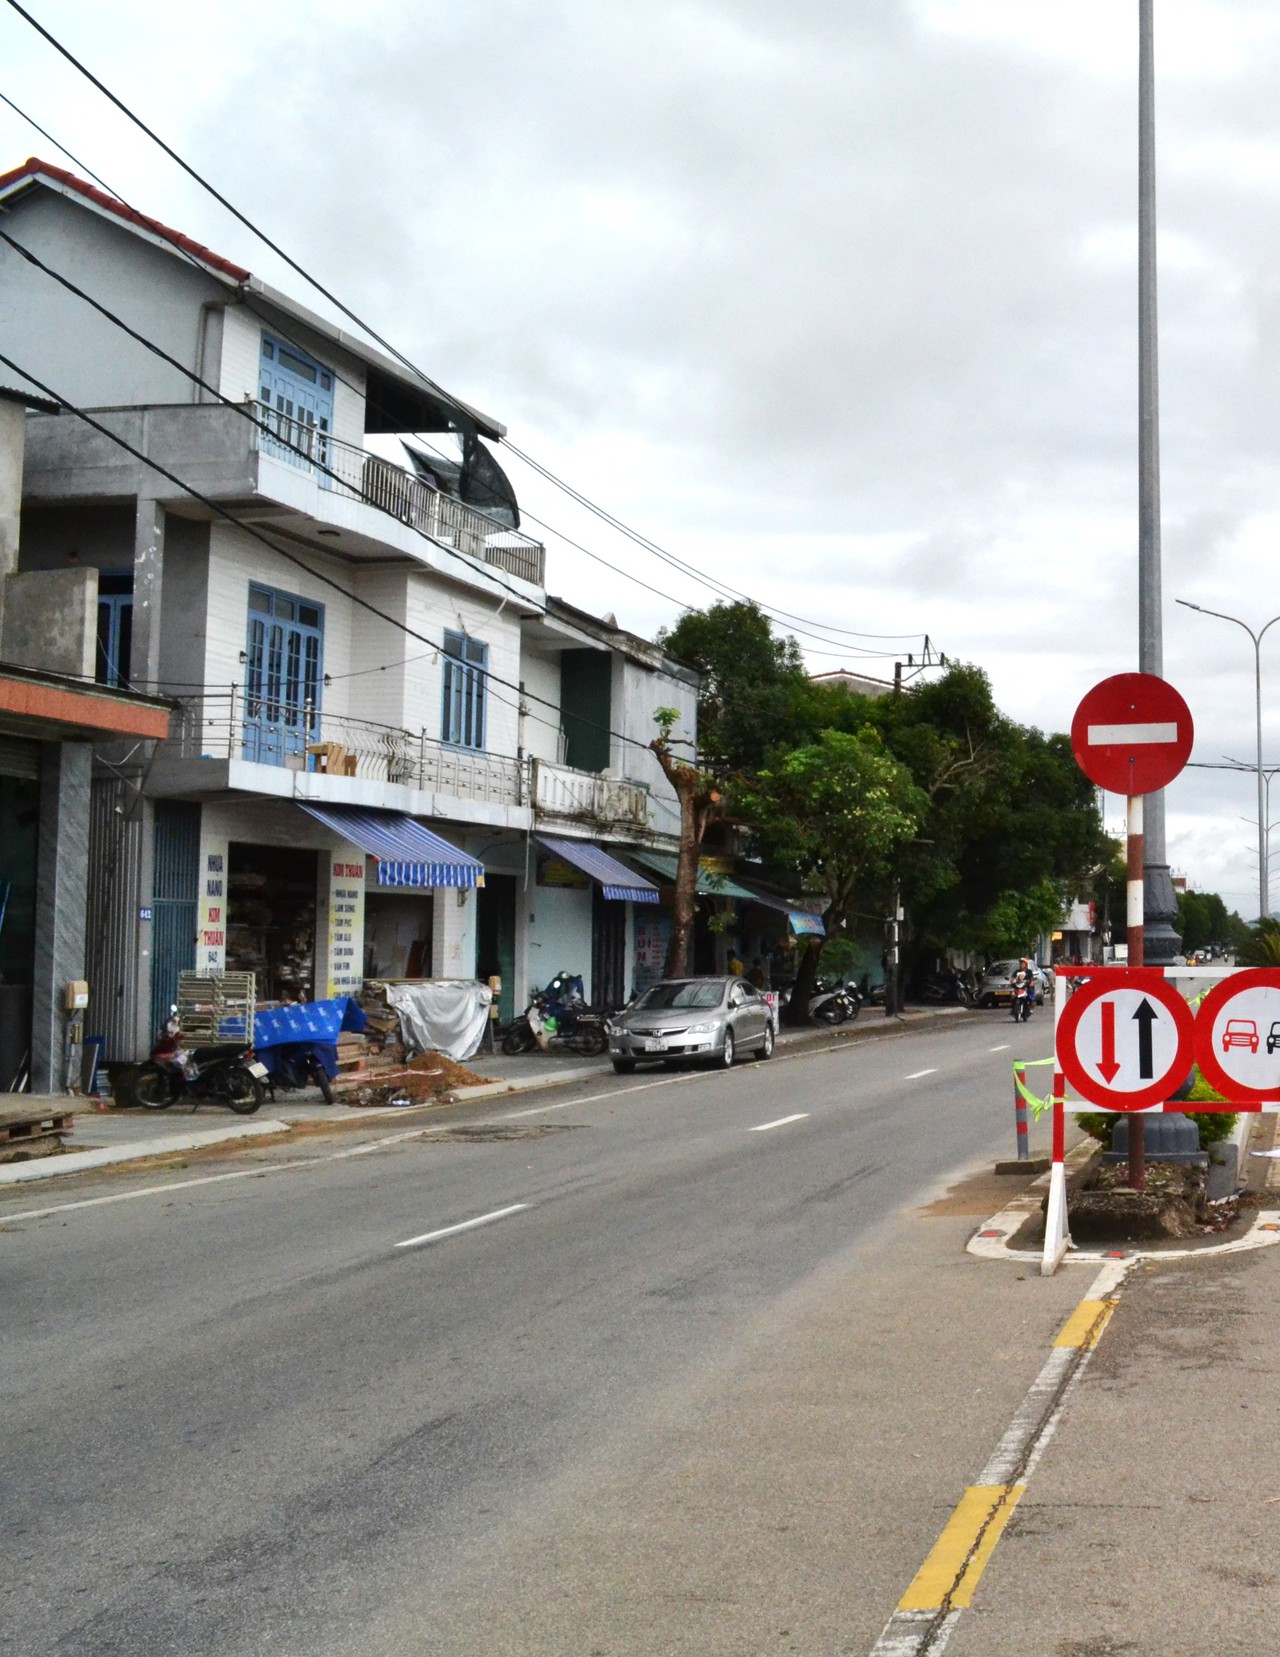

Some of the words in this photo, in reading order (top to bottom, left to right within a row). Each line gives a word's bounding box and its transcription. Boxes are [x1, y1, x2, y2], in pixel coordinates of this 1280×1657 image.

[207, 880, 222, 897] NANO
[208, 907, 220, 922] KIM
[208, 951, 218, 963] 642
